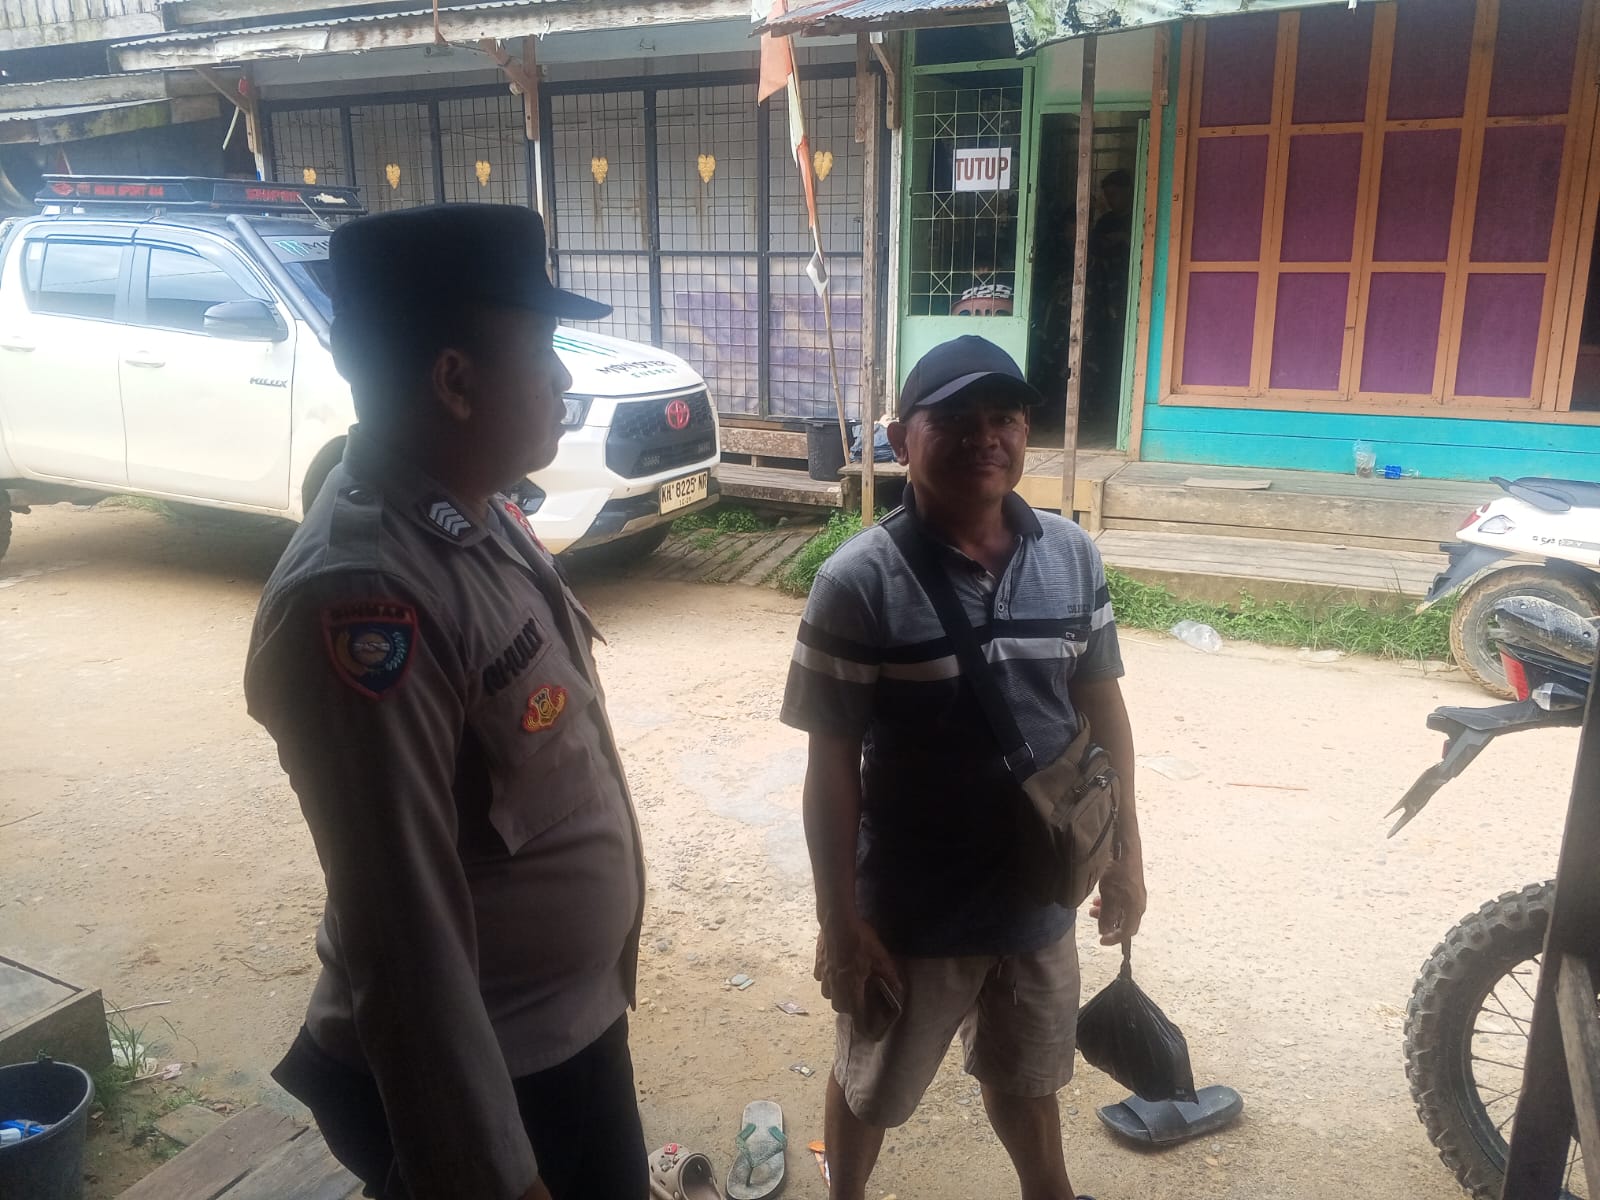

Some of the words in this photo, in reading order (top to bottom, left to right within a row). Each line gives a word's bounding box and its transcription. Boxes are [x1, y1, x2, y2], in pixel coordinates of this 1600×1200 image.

[956, 157, 1009, 181] TUTUP
[596, 360, 675, 375] MONSTER
[250, 377, 288, 388] HILUX
[661, 484, 672, 503] KH
[675, 477, 696, 498] 8225
